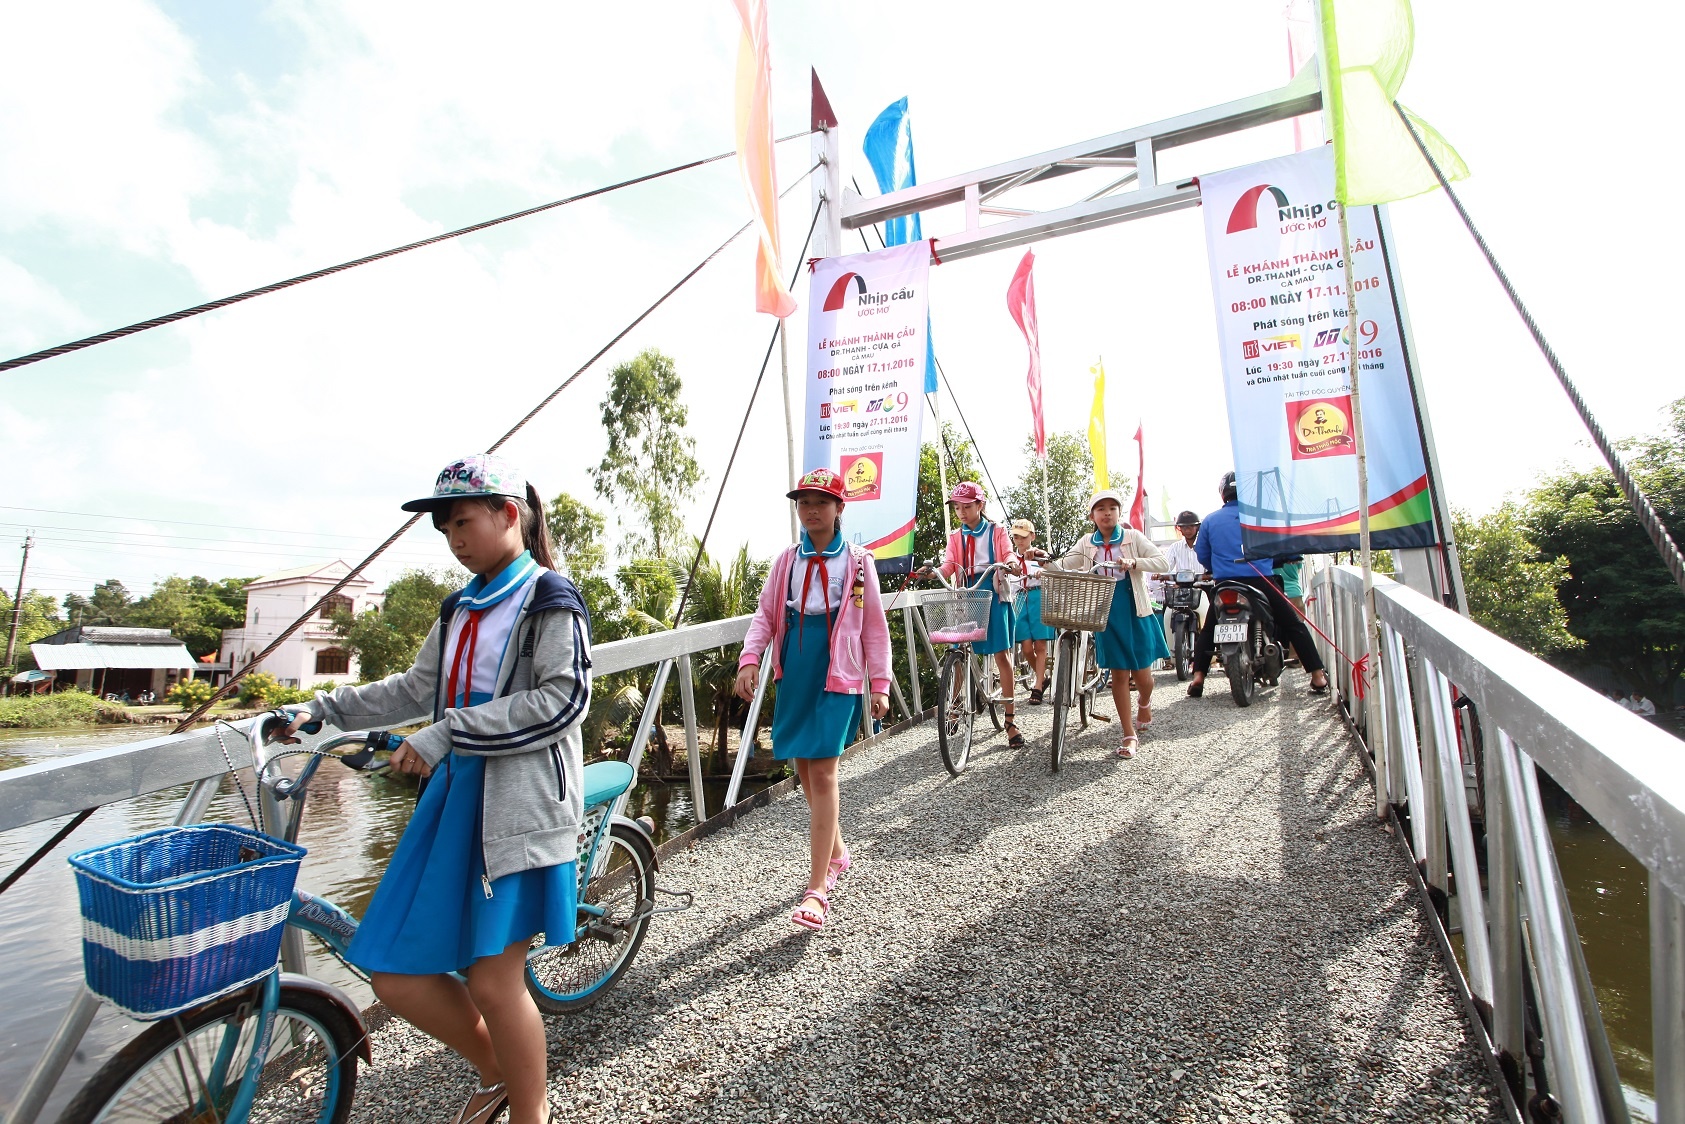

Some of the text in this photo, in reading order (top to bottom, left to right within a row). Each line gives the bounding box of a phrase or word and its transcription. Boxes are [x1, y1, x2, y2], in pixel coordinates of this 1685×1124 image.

[1278, 203, 1323, 222] Nhịp
[1280, 217, 1327, 235] ƯỚC MƠ
[1226, 264, 1239, 279] LỄ
[1243, 258, 1290, 276] KHÁNH
[1293, 248, 1339, 265] THÀNH
[1248, 267, 1301, 285] DR.THANH
[1280, 275, 1315, 288] CÀ MAU
[858, 287, 915, 306] Nhịp cầu
[1231, 276, 1380, 313] 08:00 NGÀY 17.11.016
[877, 306, 890, 315] MƠ
[1253, 320, 1278, 331] Phát
[1281, 316, 1305, 328] sóng
[1308, 311, 1330, 324] trên
[830, 336, 860, 348] KHÁNH
[863, 331, 894, 343] THÀNH
[830, 345, 866, 356] DR.THANH
[817, 358, 915, 380] 08:00 NGÀY 17.11.2016
[1246, 348, 1382, 375] Lúc 19:30 ngày 27.12016
[1328, 366, 1346, 375] cùng
[1362, 362, 1384, 370] tháng
[870, 415, 908, 427] 27.11.2016
[1216, 632, 1244, 641] 179.11
